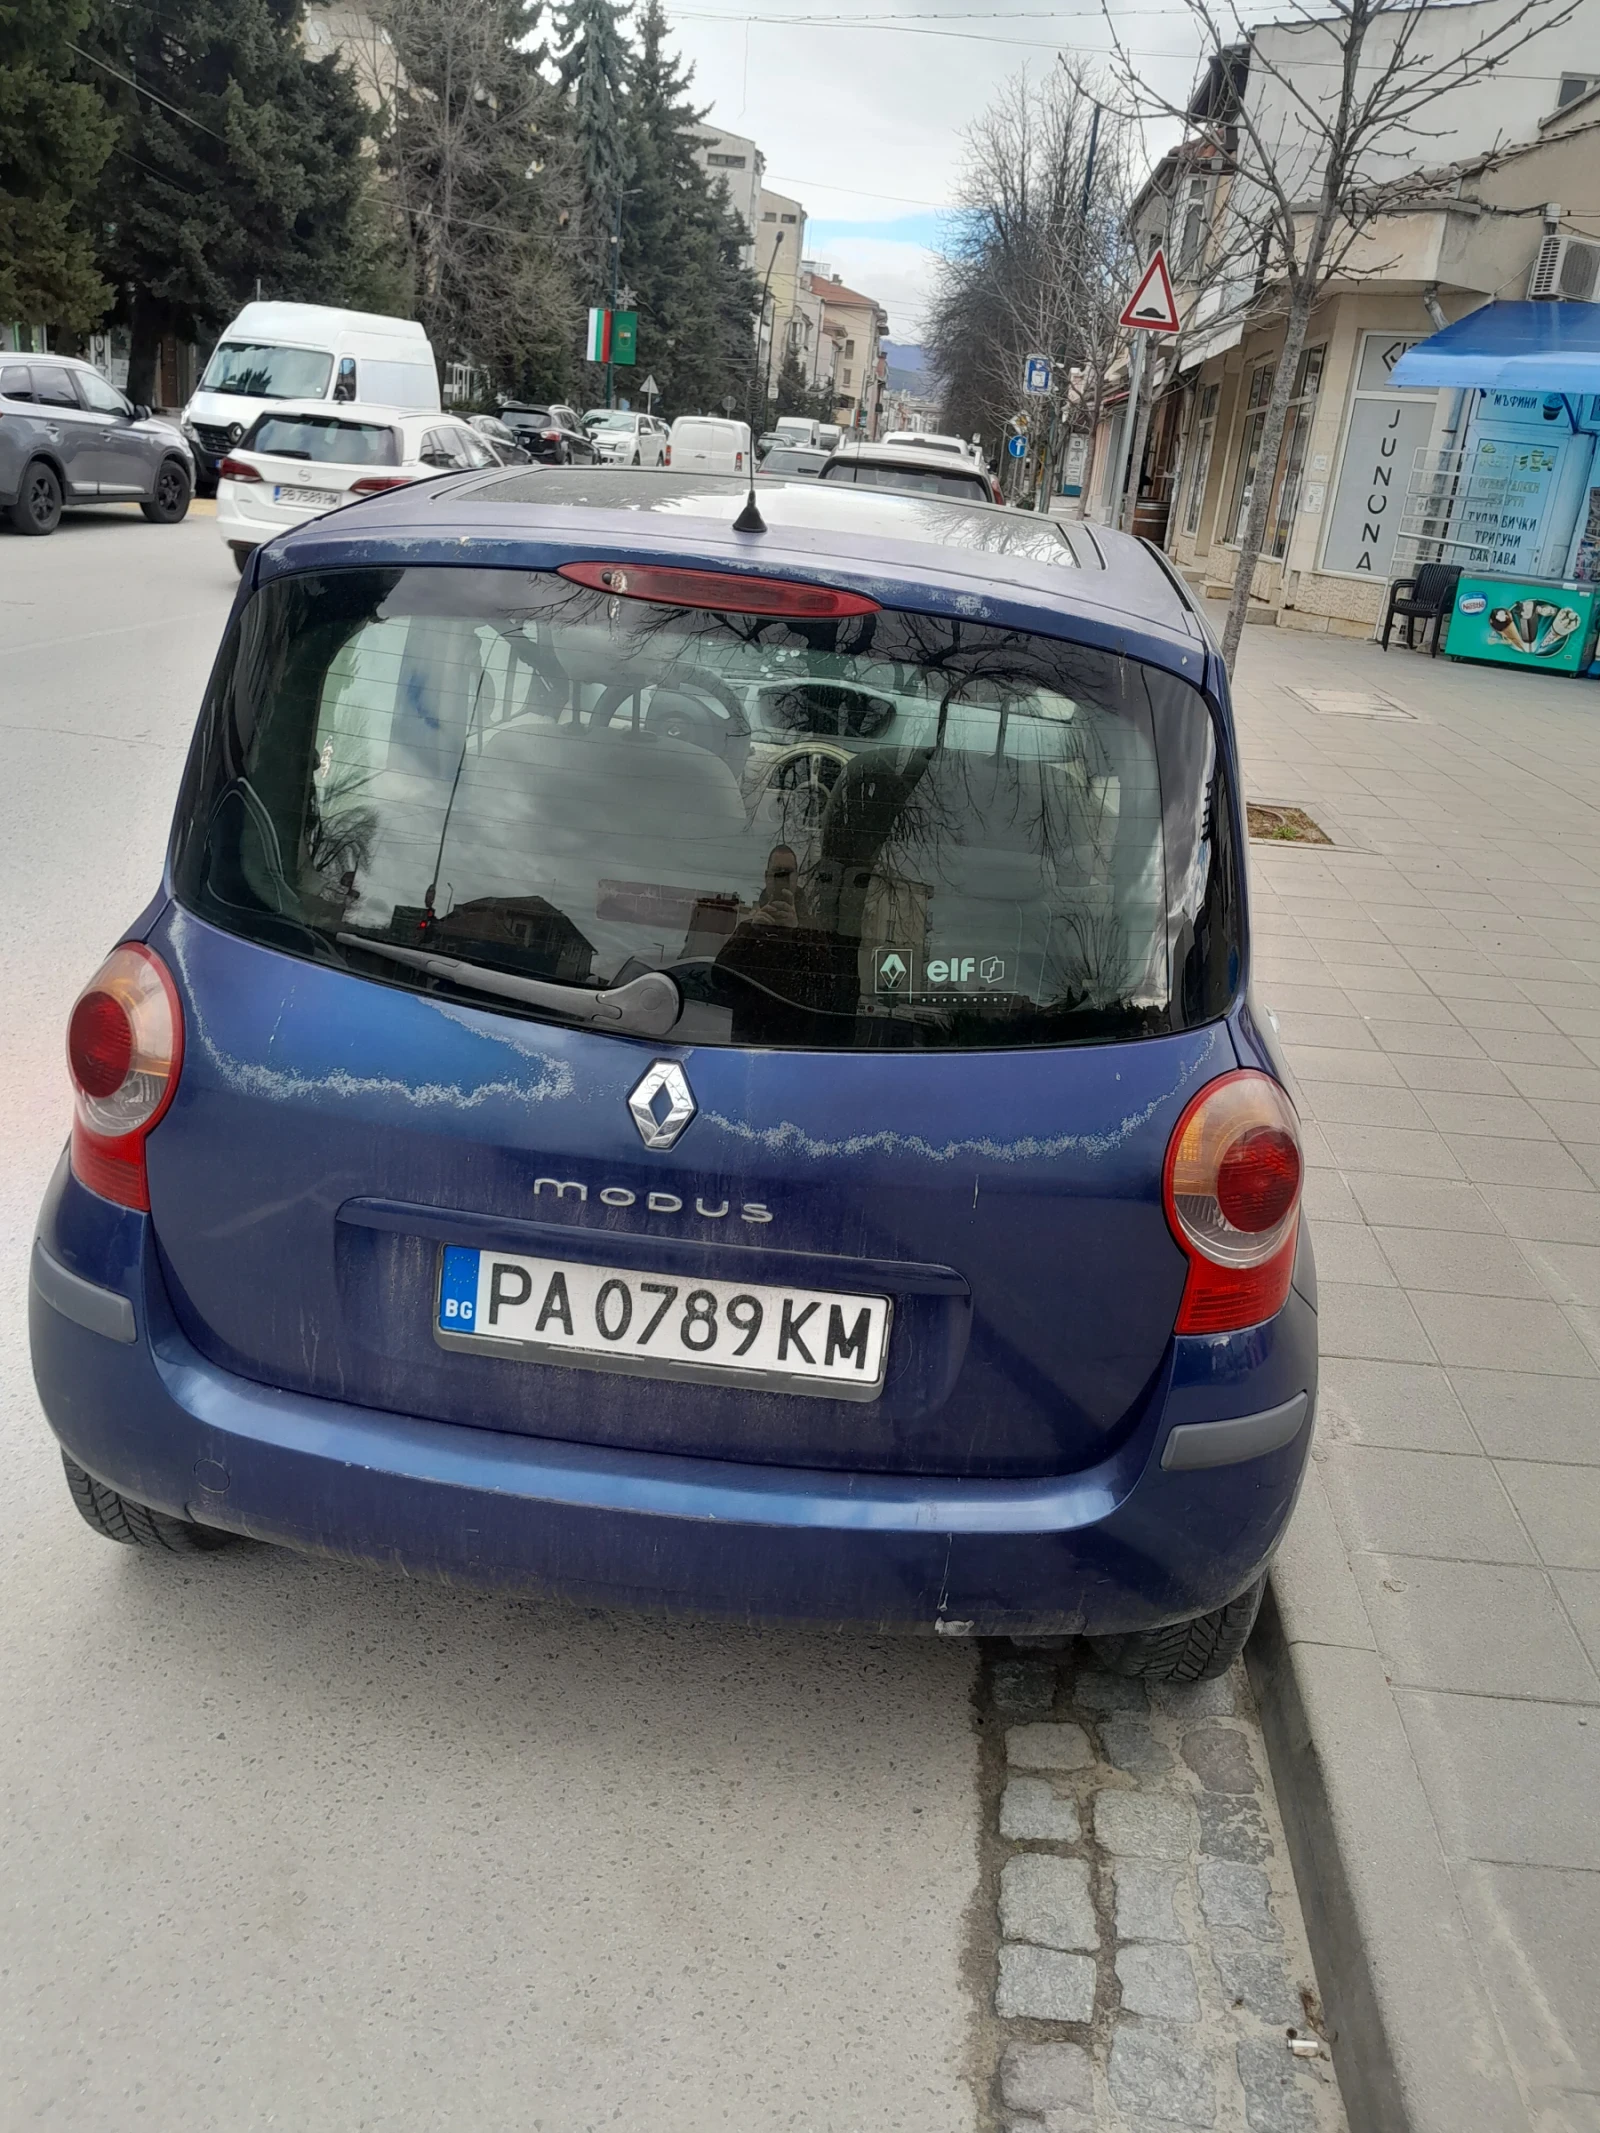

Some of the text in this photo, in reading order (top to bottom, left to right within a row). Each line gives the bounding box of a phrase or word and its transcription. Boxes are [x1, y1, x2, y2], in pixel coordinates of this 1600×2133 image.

[1494, 394, 1538, 409] МЪФИНИ
[1355, 408, 1401, 571] JUNONA
[926, 957, 976, 983] elf
[533, 1177, 774, 1223] MODUS
[445, 1299, 473, 1320] BG
